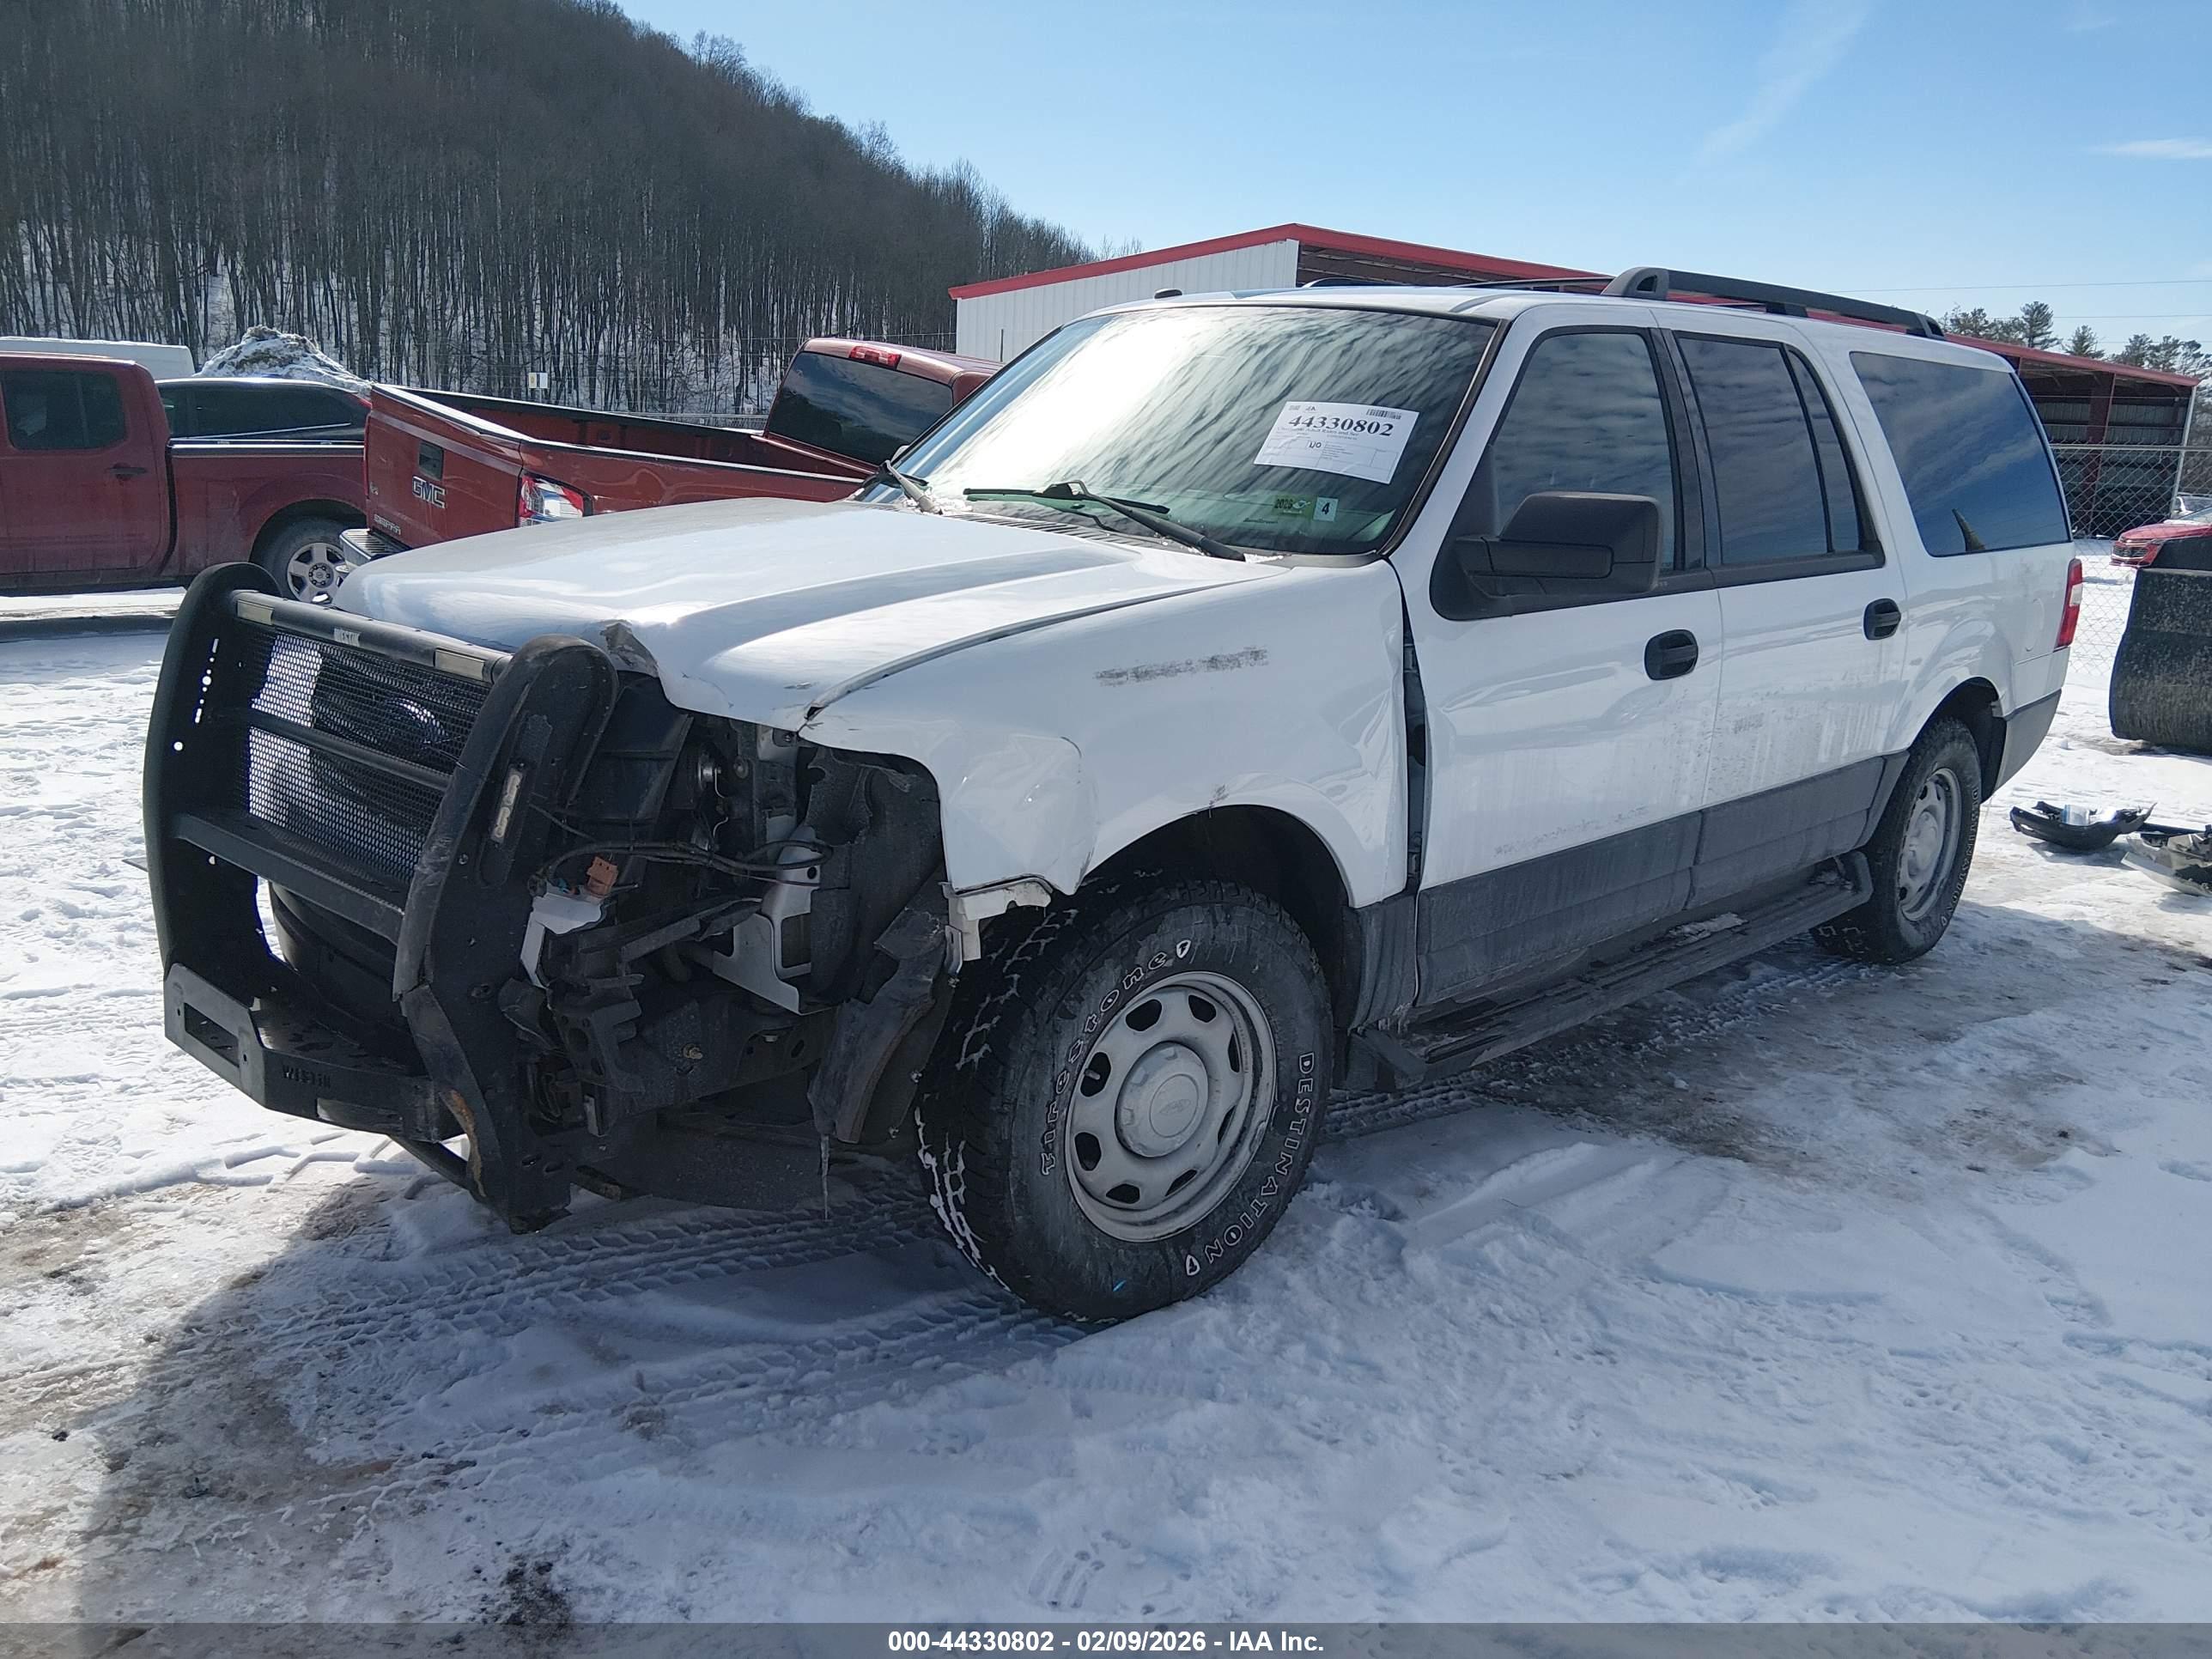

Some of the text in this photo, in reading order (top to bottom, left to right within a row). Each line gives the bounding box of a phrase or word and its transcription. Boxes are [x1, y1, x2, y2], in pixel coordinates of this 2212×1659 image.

[1289, 416, 1394, 437] 44330802
[412, 475, 447, 509] GMC
[1322, 501, 1330, 515] 4
[1041, 952, 1168, 1176] Firestone
[1204, 1052, 1315, 1263] DESTINATION
